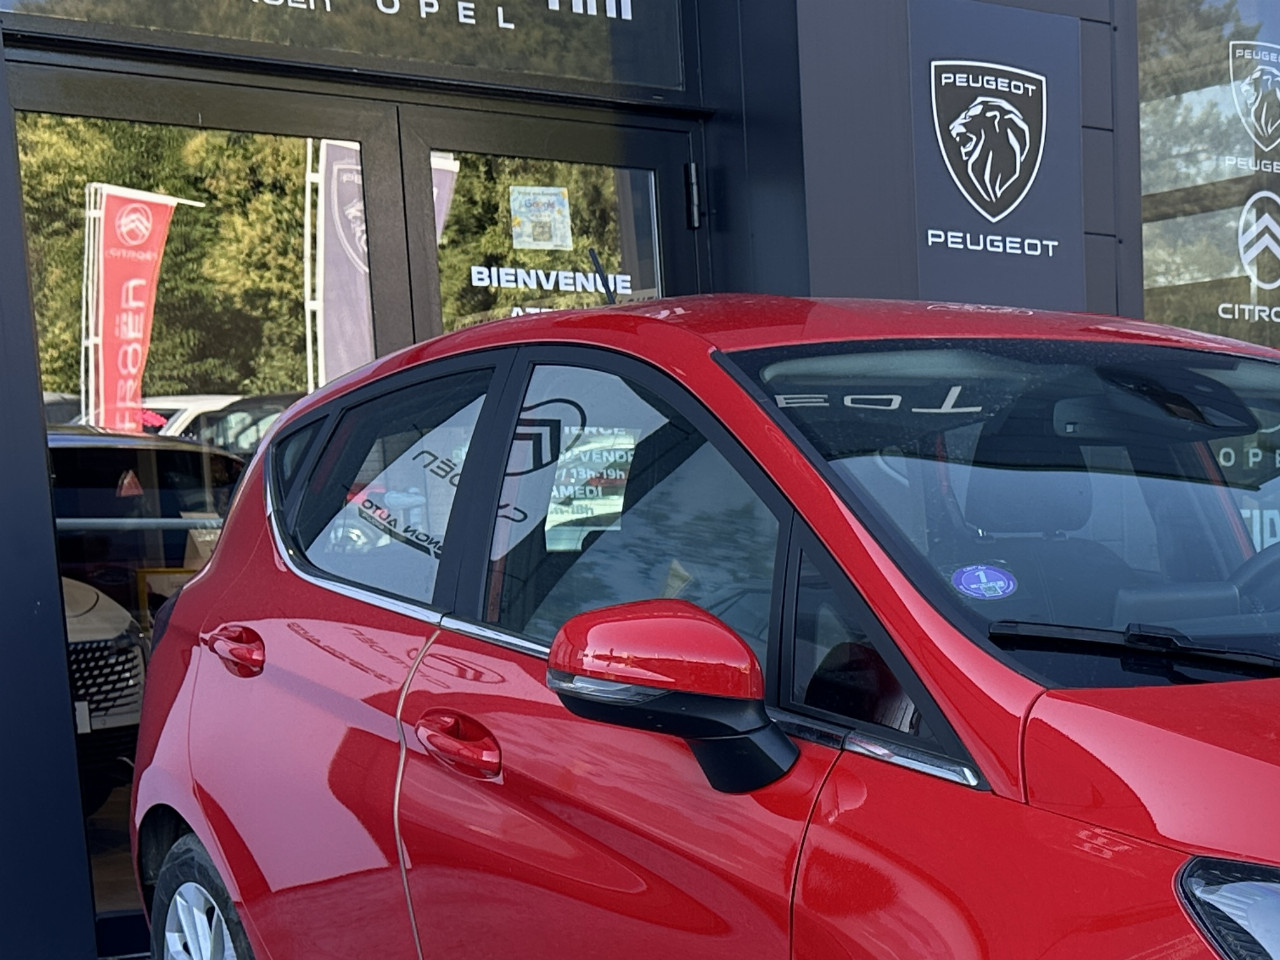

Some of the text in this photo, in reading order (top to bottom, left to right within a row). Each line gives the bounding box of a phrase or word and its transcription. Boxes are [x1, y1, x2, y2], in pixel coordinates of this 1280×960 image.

[376, 0, 515, 29] OPEL
[941, 73, 1036, 97] PEUGEOT
[927, 229, 1059, 257] PEUGEOT
[471, 266, 632, 295] BIENVENUE
